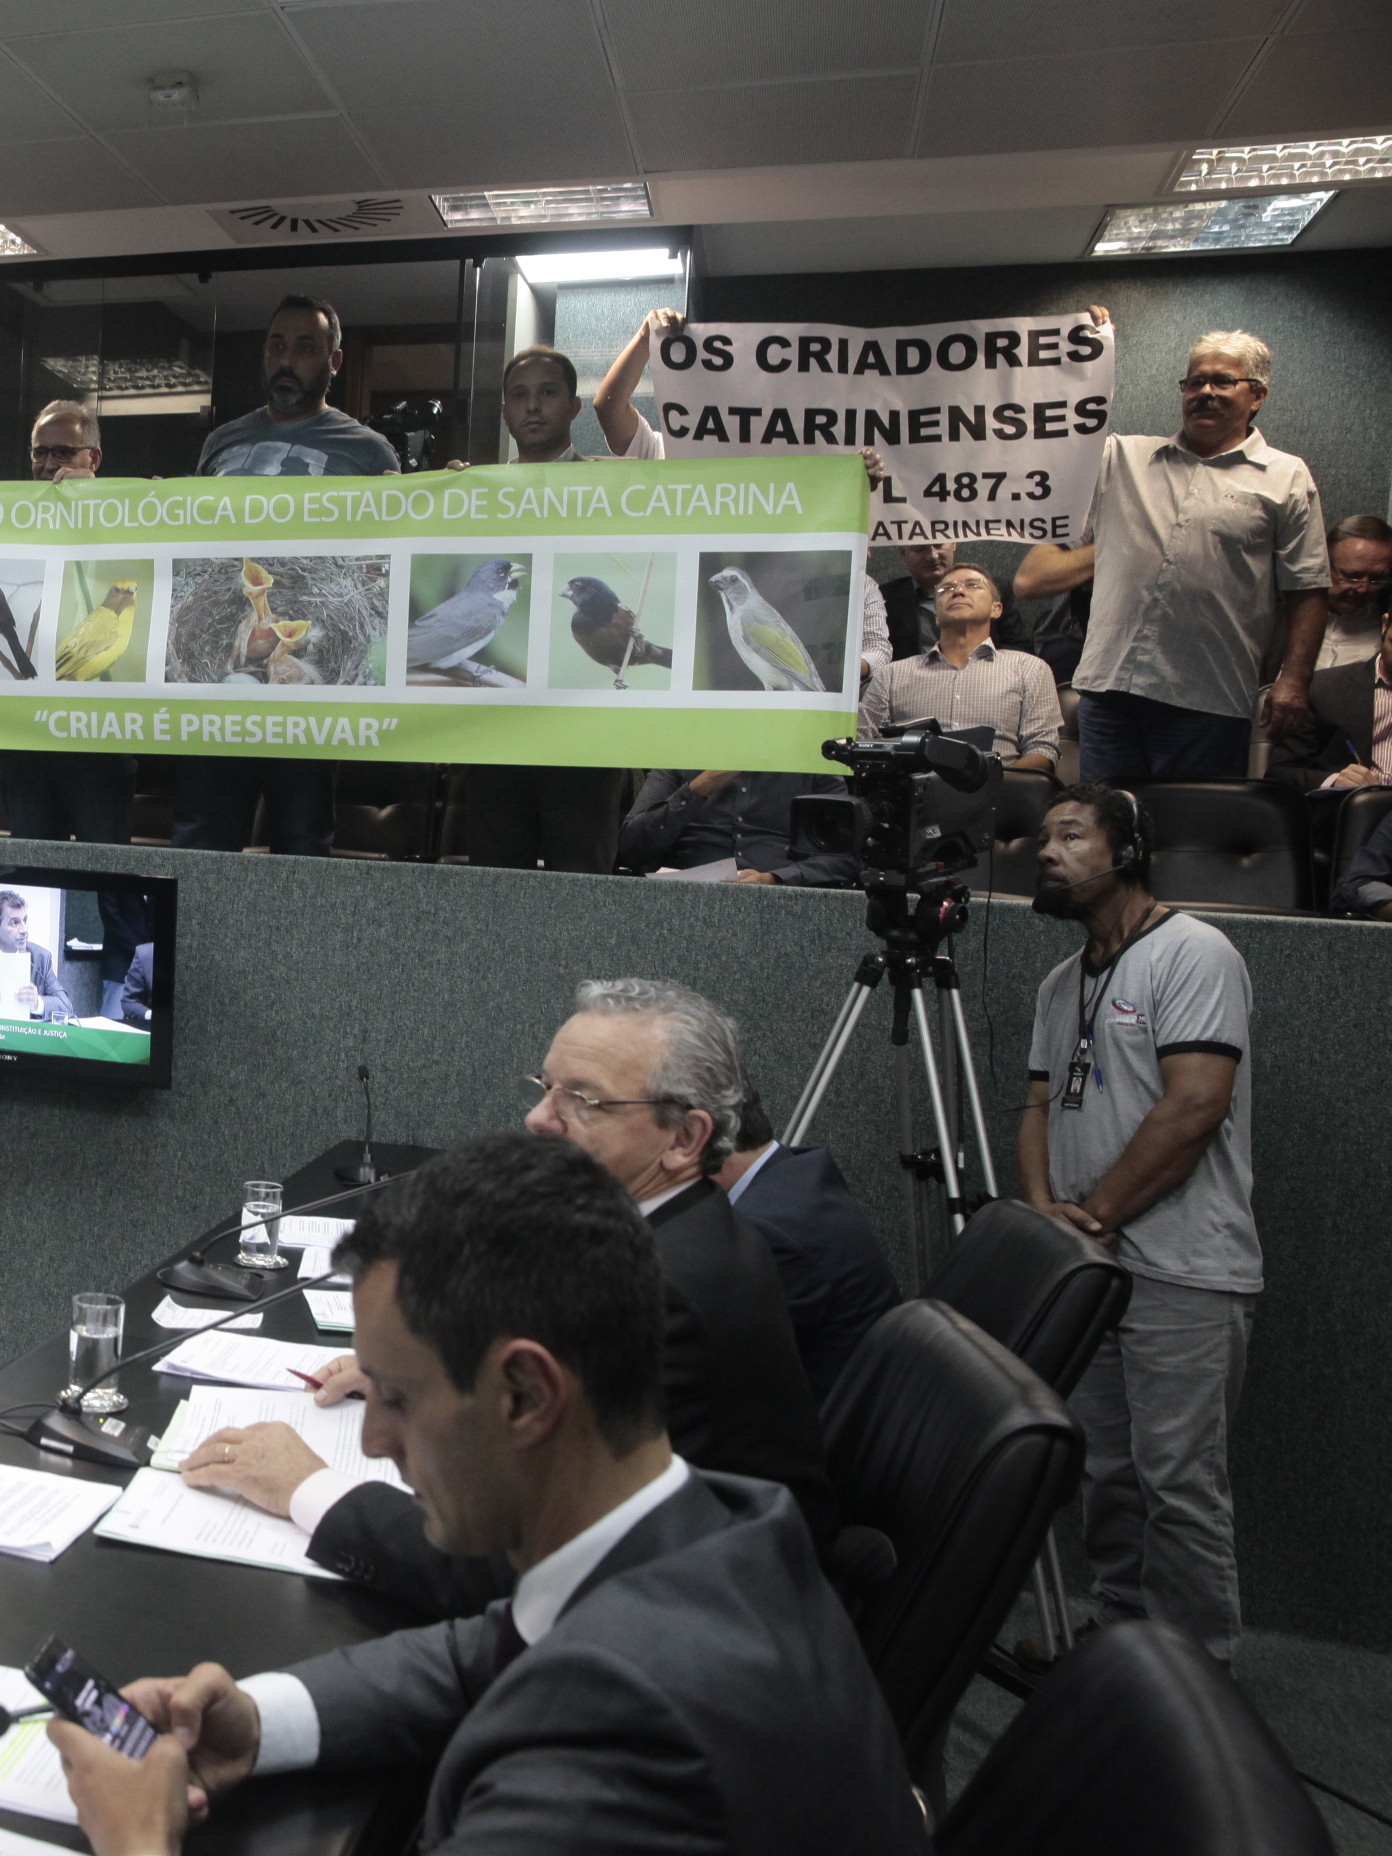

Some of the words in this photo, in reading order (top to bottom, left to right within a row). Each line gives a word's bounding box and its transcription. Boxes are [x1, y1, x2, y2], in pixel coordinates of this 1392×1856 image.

[659, 334, 735, 374] OS
[755, 323, 1105, 377] CRIADORES
[661, 395, 1108, 447] CATARINENSES
[923, 469, 1052, 503] 487.3
[10, 491, 237, 530] ORNITOLÓGICA
[244, 493, 295, 524] DO
[303, 488, 435, 523] ESTADO
[443, 488, 489, 520] DE
[497, 485, 611, 519] SANTA
[620, 481, 804, 518] CATARINA
[871, 515, 1070, 541] ATARINENSE
[153, 706, 172, 741] É
[42, 1029, 68, 1039] JUSTIÇA
